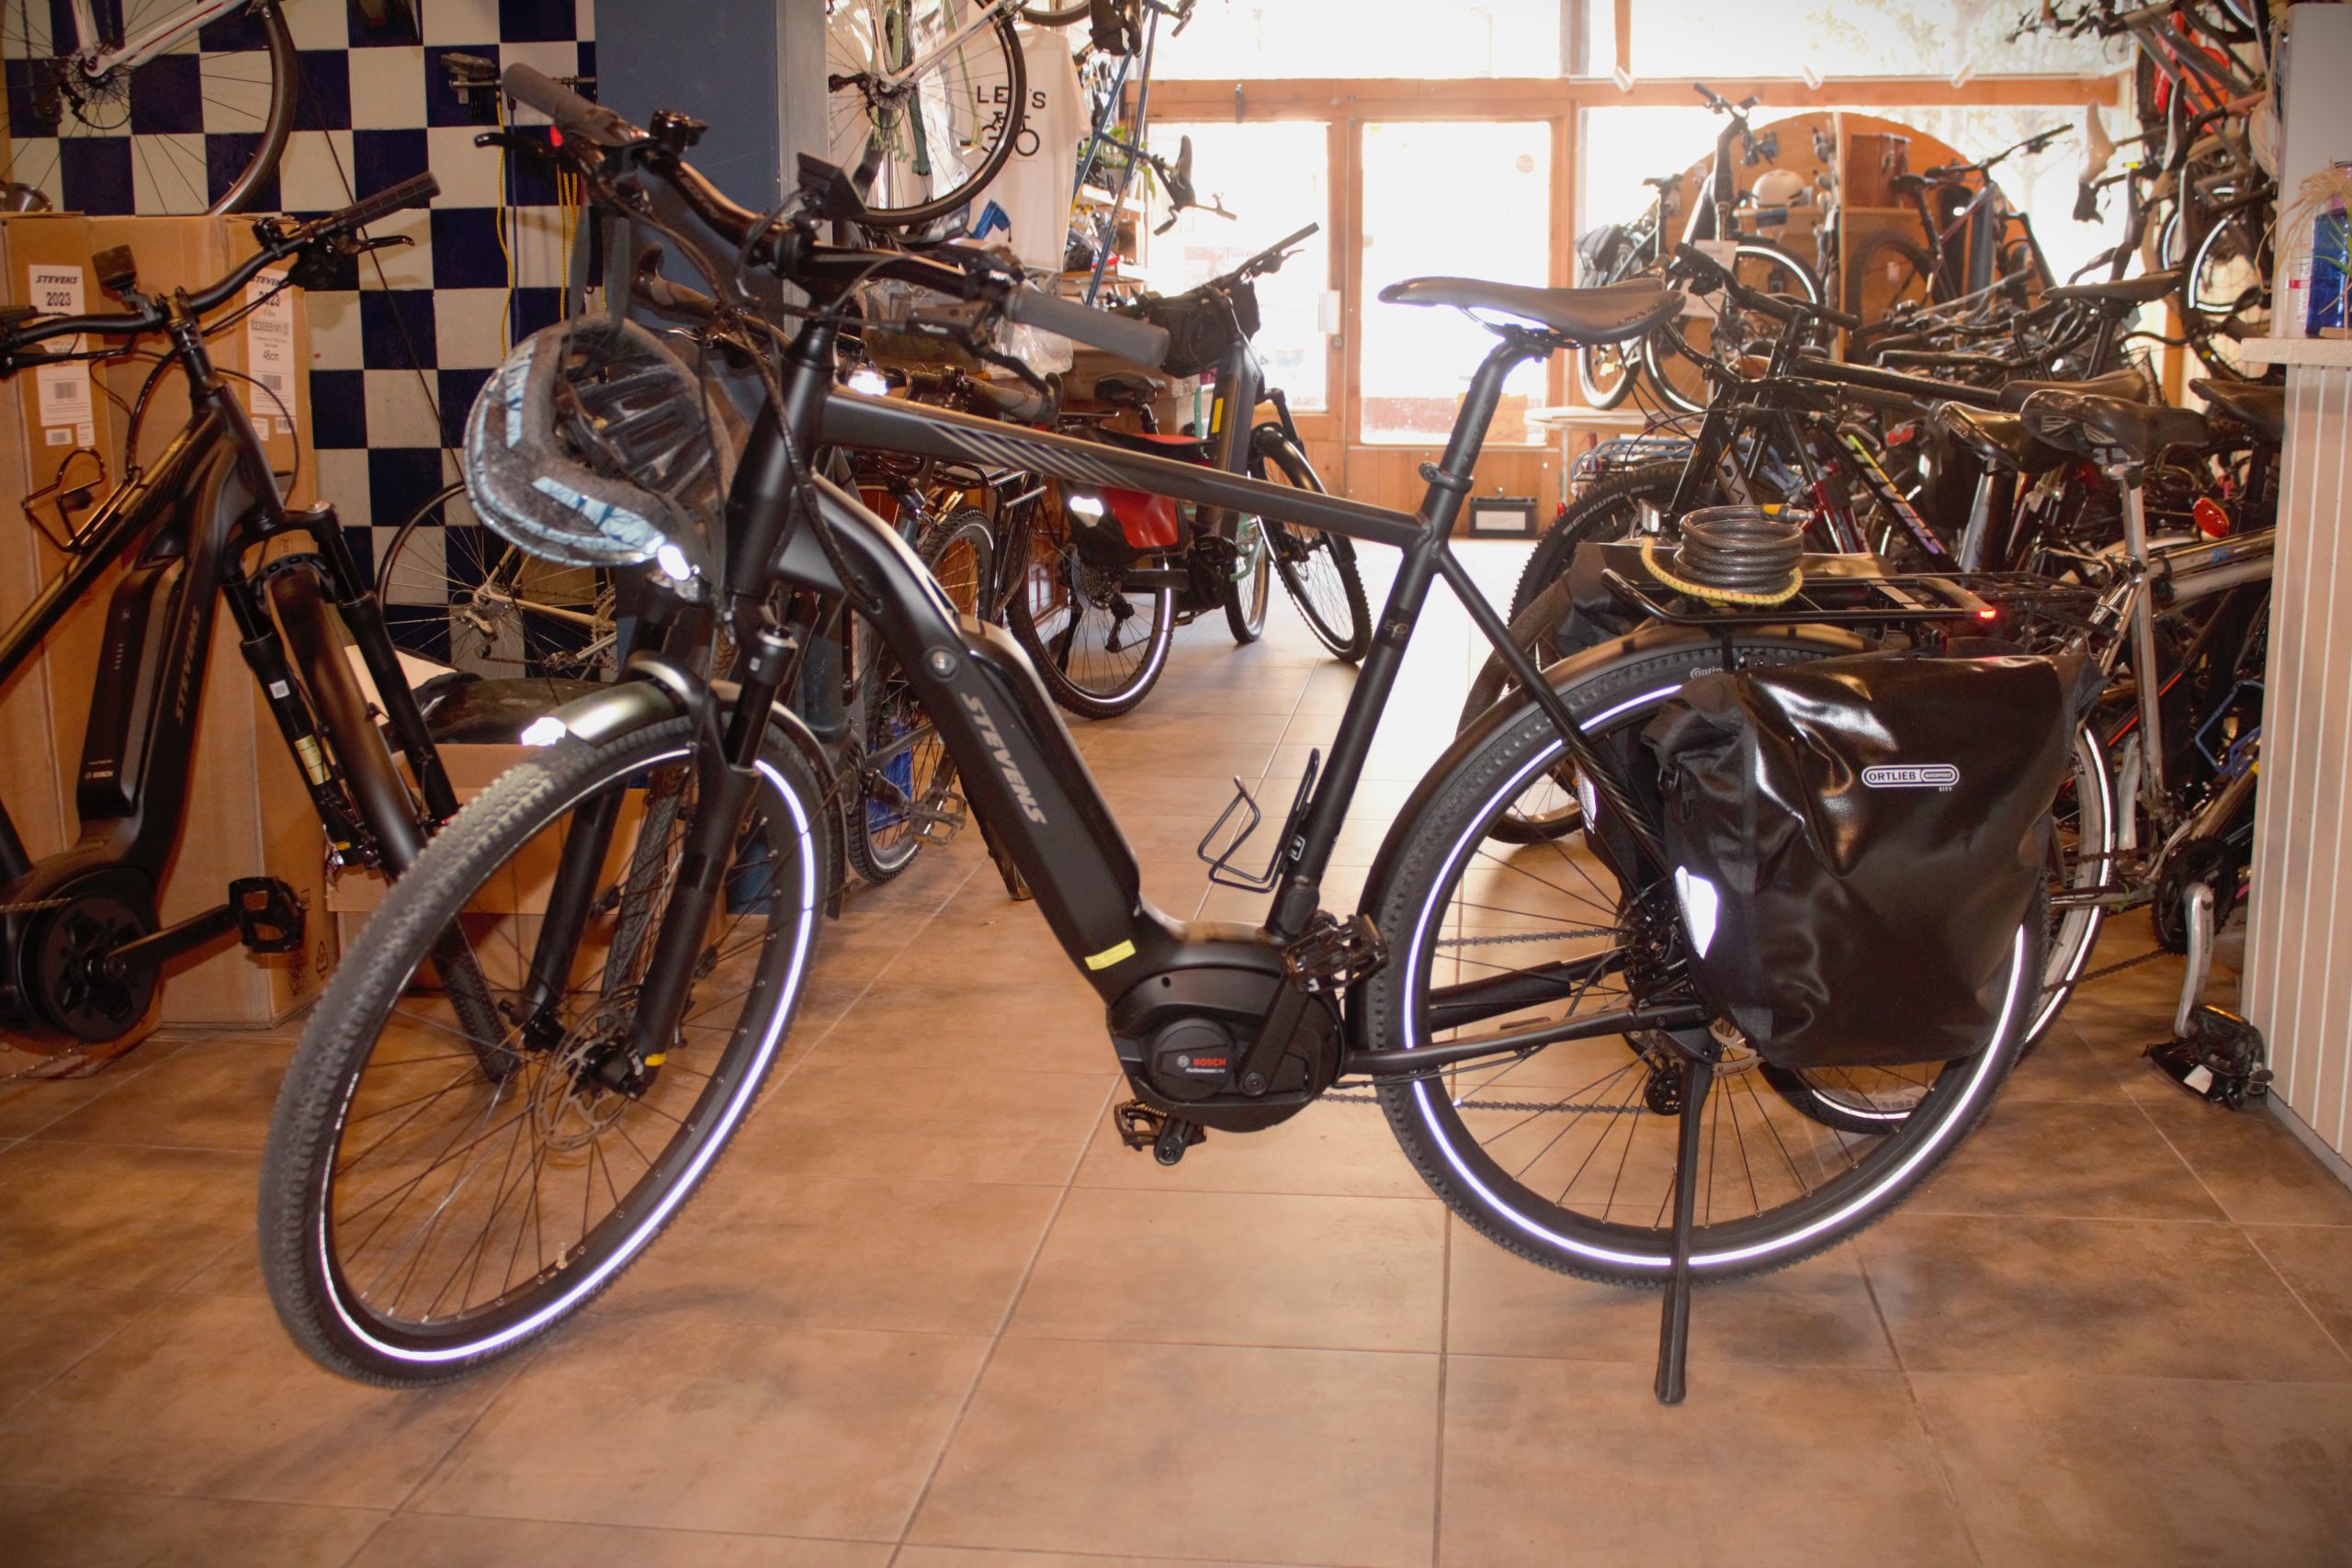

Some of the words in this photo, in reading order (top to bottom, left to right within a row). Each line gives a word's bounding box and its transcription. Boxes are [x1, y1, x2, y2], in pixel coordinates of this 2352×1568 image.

[977, 85, 1046, 109] LE'S
[36, 275, 79, 284] STEVENS
[46, 291, 72, 307] 2023
[960, 693, 1048, 825] STEVENS
[1869, 772, 1917, 781] ORTLIEB
[1193, 1058, 1227, 1066] BOSCH
